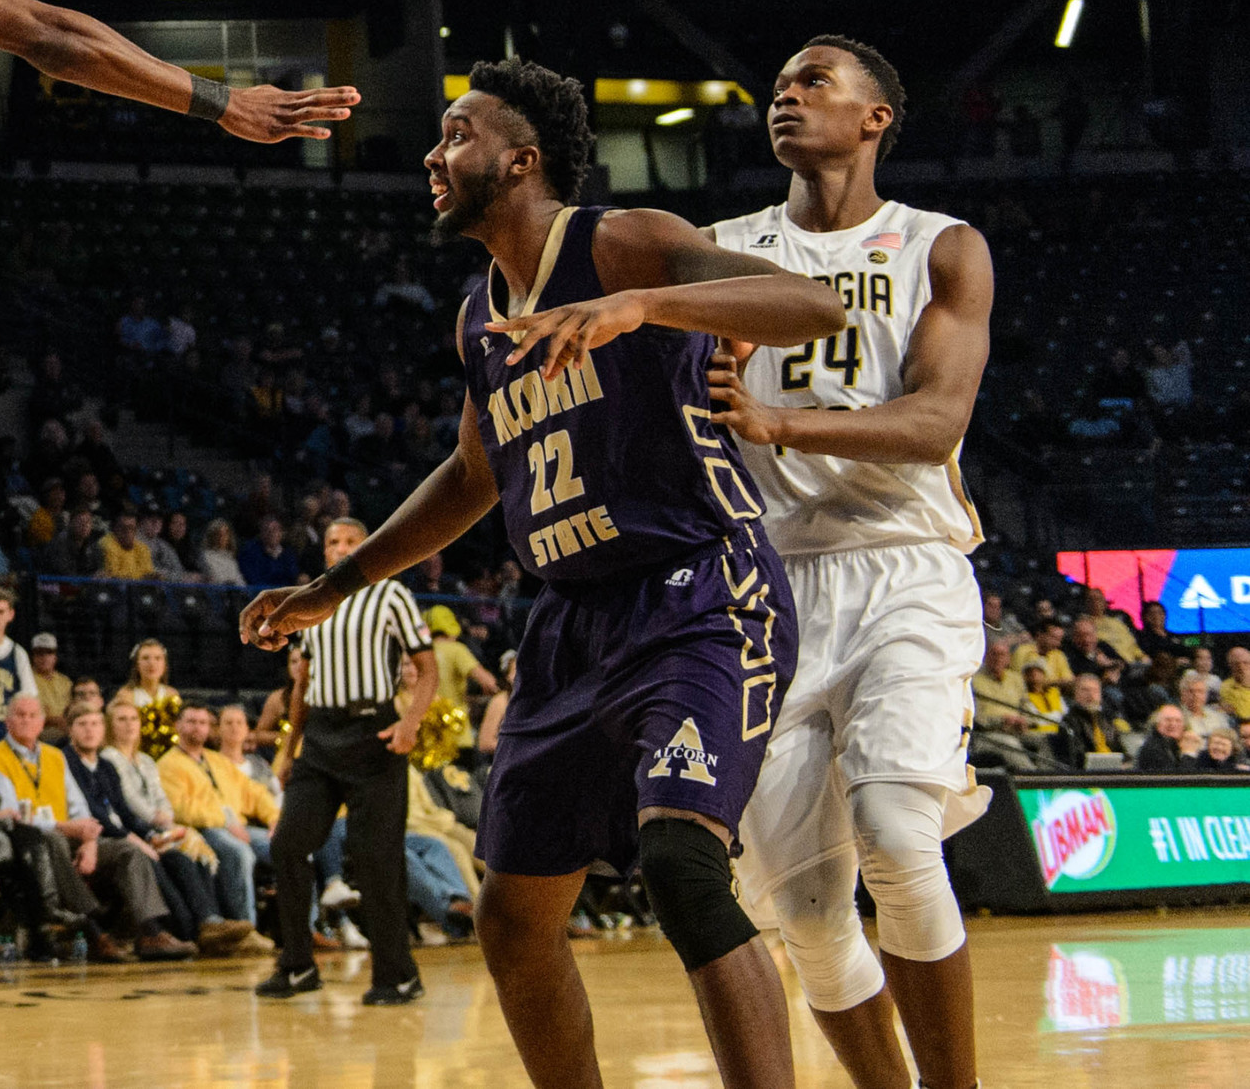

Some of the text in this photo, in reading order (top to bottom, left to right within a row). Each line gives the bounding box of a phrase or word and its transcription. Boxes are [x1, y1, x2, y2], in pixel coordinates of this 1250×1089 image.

[781, 325, 862, 392] 24
[527, 429, 586, 515] 22
[528, 504, 620, 568] STATE
[653, 747, 718, 767] ALCORN
[1032, 794, 1113, 887] LIBMAN
[1148, 816, 1181, 863] #1
[1175, 816, 1210, 862] IN
